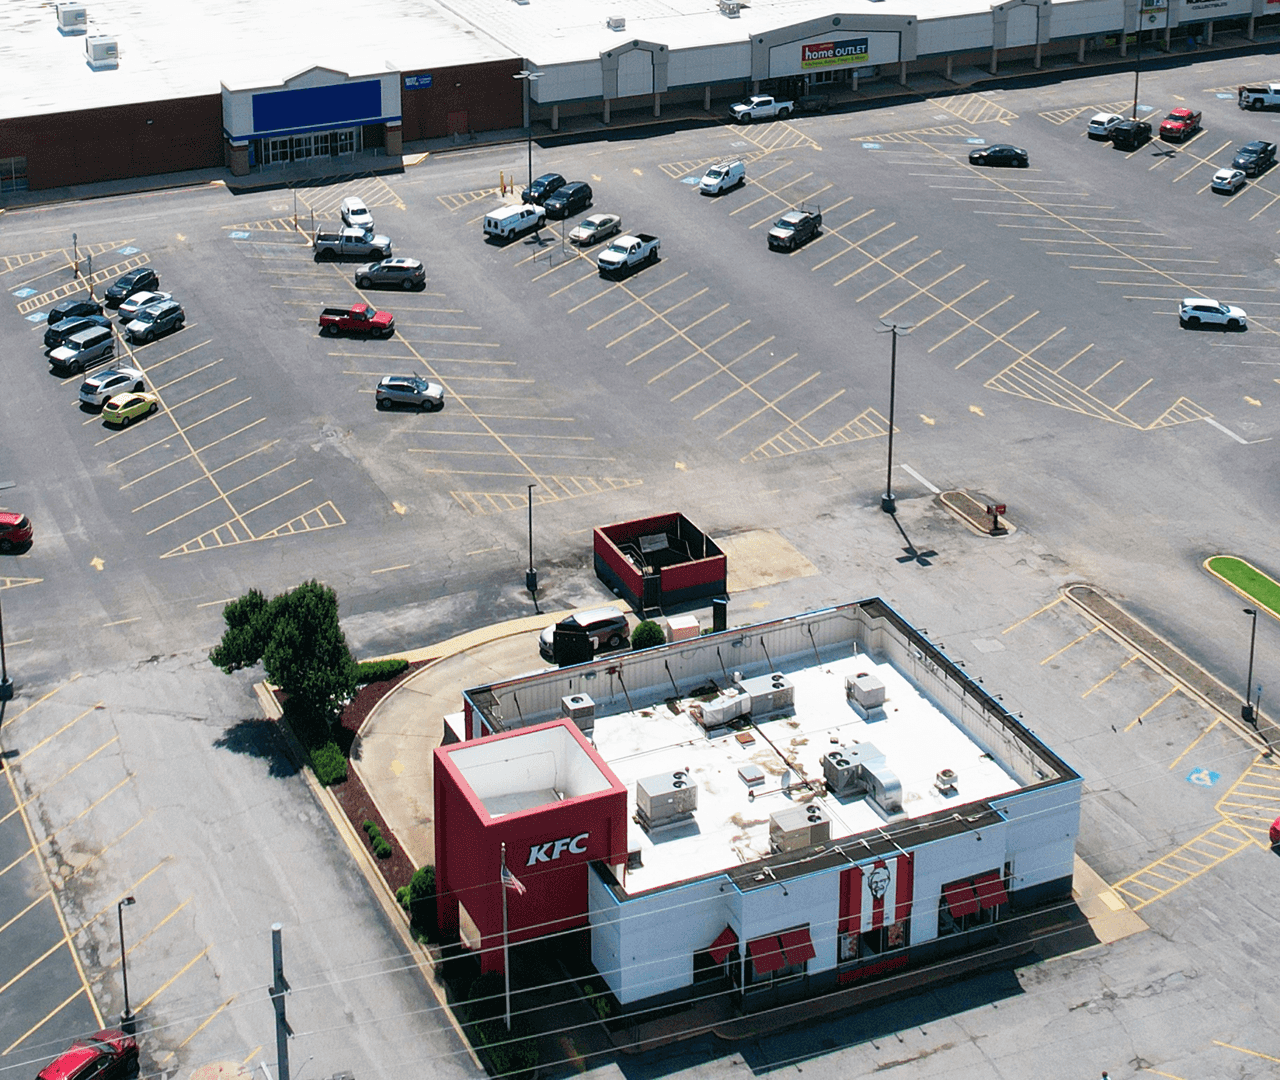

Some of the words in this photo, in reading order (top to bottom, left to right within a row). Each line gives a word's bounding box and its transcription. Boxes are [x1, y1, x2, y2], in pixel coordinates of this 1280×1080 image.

[805, 47, 834, 59] home
[835, 45, 867, 56] OUTLET
[526, 832, 590, 866] KFC
